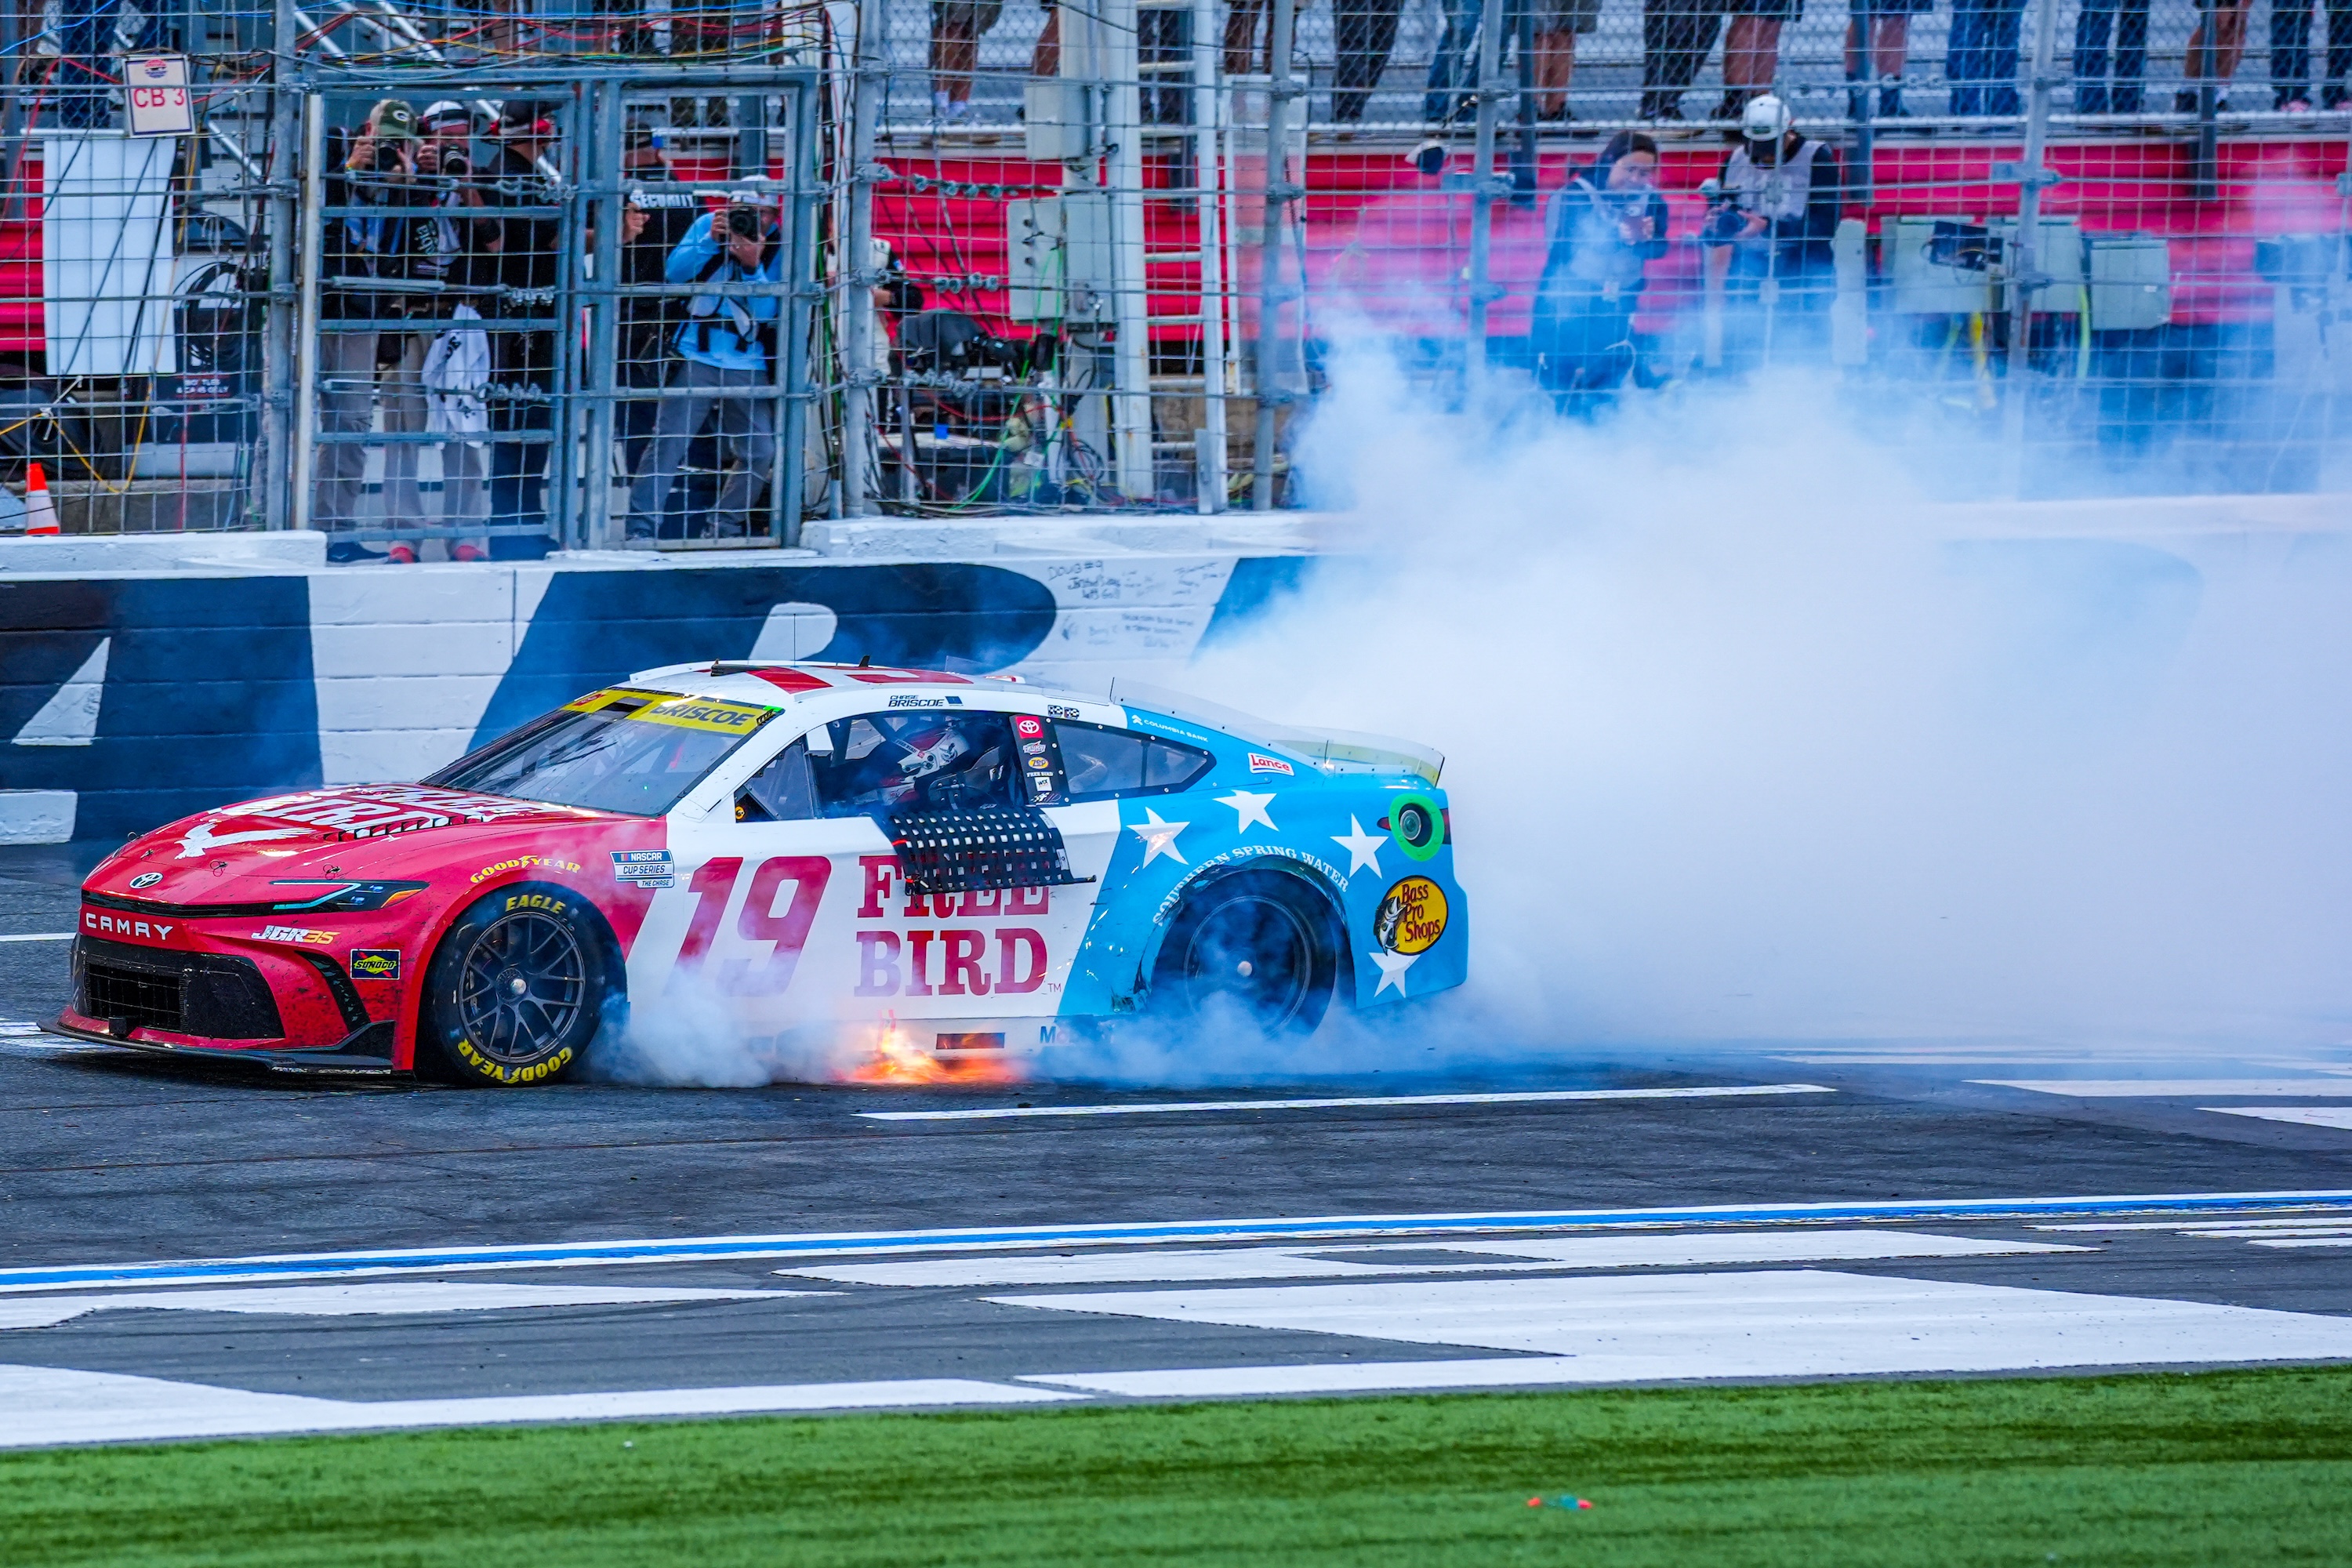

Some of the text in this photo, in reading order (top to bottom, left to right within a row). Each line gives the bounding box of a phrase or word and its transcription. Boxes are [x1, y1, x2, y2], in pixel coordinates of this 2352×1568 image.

[133, 85, 185, 108] CB 3
[888, 699, 945, 707] BRISCOE
[650, 704, 755, 726] BRISCOE
[1143, 719, 1208, 742] COLUMBIA BANK
[1250, 754, 1290, 771] Lance
[631, 852, 662, 862] NASCAR
[470, 855, 581, 884] GOODYEAR
[623, 865, 666, 874] CUP SERIES
[1232, 845, 1298, 858] SPRING
[1300, 851, 1349, 892] WATER
[505, 895, 566, 914] EAGLE
[1401, 884, 1429, 904] Bass
[1403, 903, 1425, 922] Pro
[85, 913, 173, 941] CAMRY
[662, 855, 833, 997] 19
[1404, 919, 1441, 942] Shops
[356, 960, 396, 969] SUNOCO
[854, 927, 1048, 997] BIRD
[458, 1038, 573, 1084] GOODYEAR
